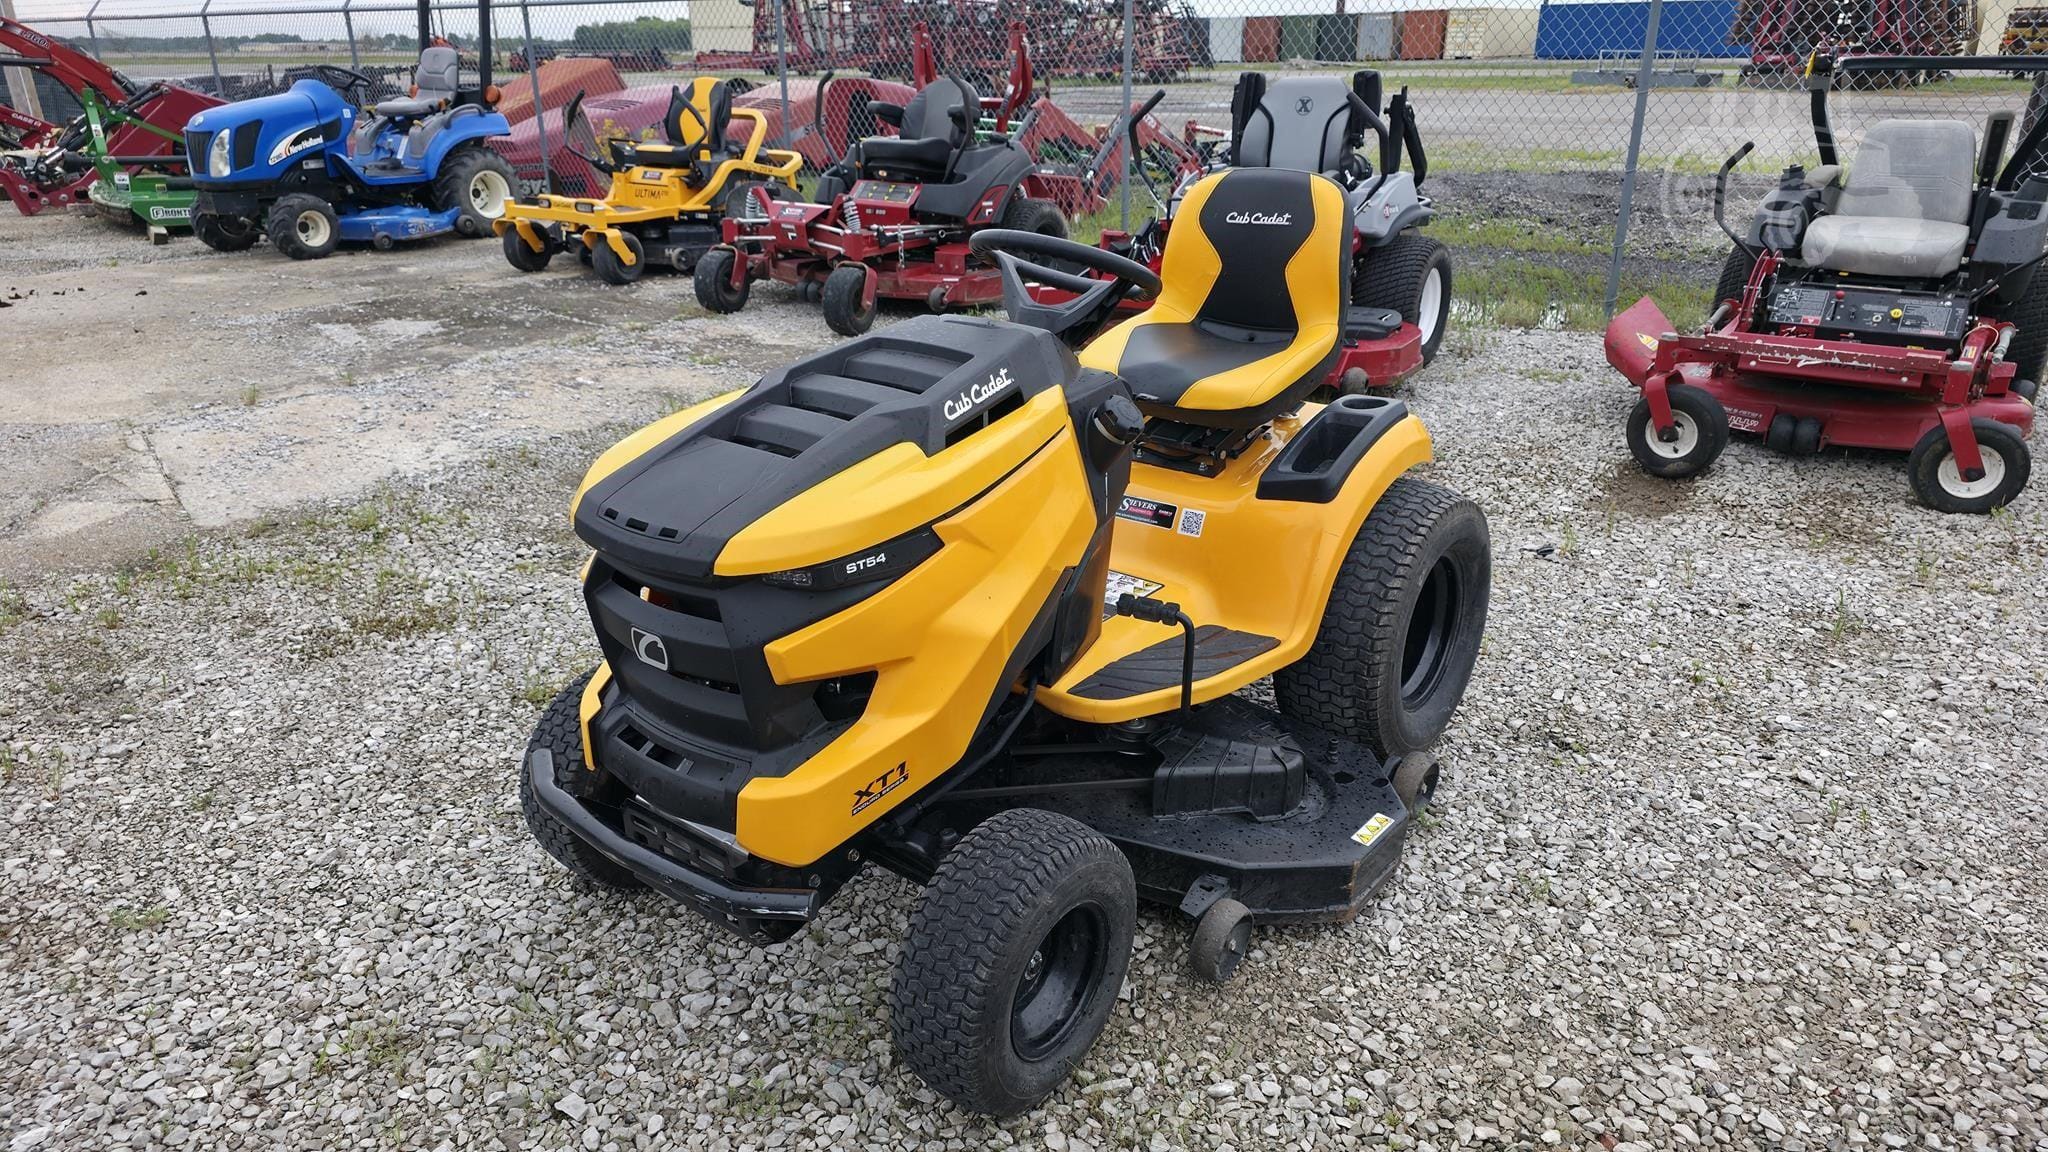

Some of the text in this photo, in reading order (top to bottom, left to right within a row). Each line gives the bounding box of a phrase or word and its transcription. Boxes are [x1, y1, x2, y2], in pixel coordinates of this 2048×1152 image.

[635, 188, 662, 199] ULTIMA
[151, 207, 191, 219] FRONTI
[1226, 211, 1291, 225] Cub Cadet
[944, 368, 1012, 420] Cub Cadet
[1120, 497, 1158, 511] SIEVERS
[846, 553, 887, 574] ST54
[852, 760, 907, 808] XT1
